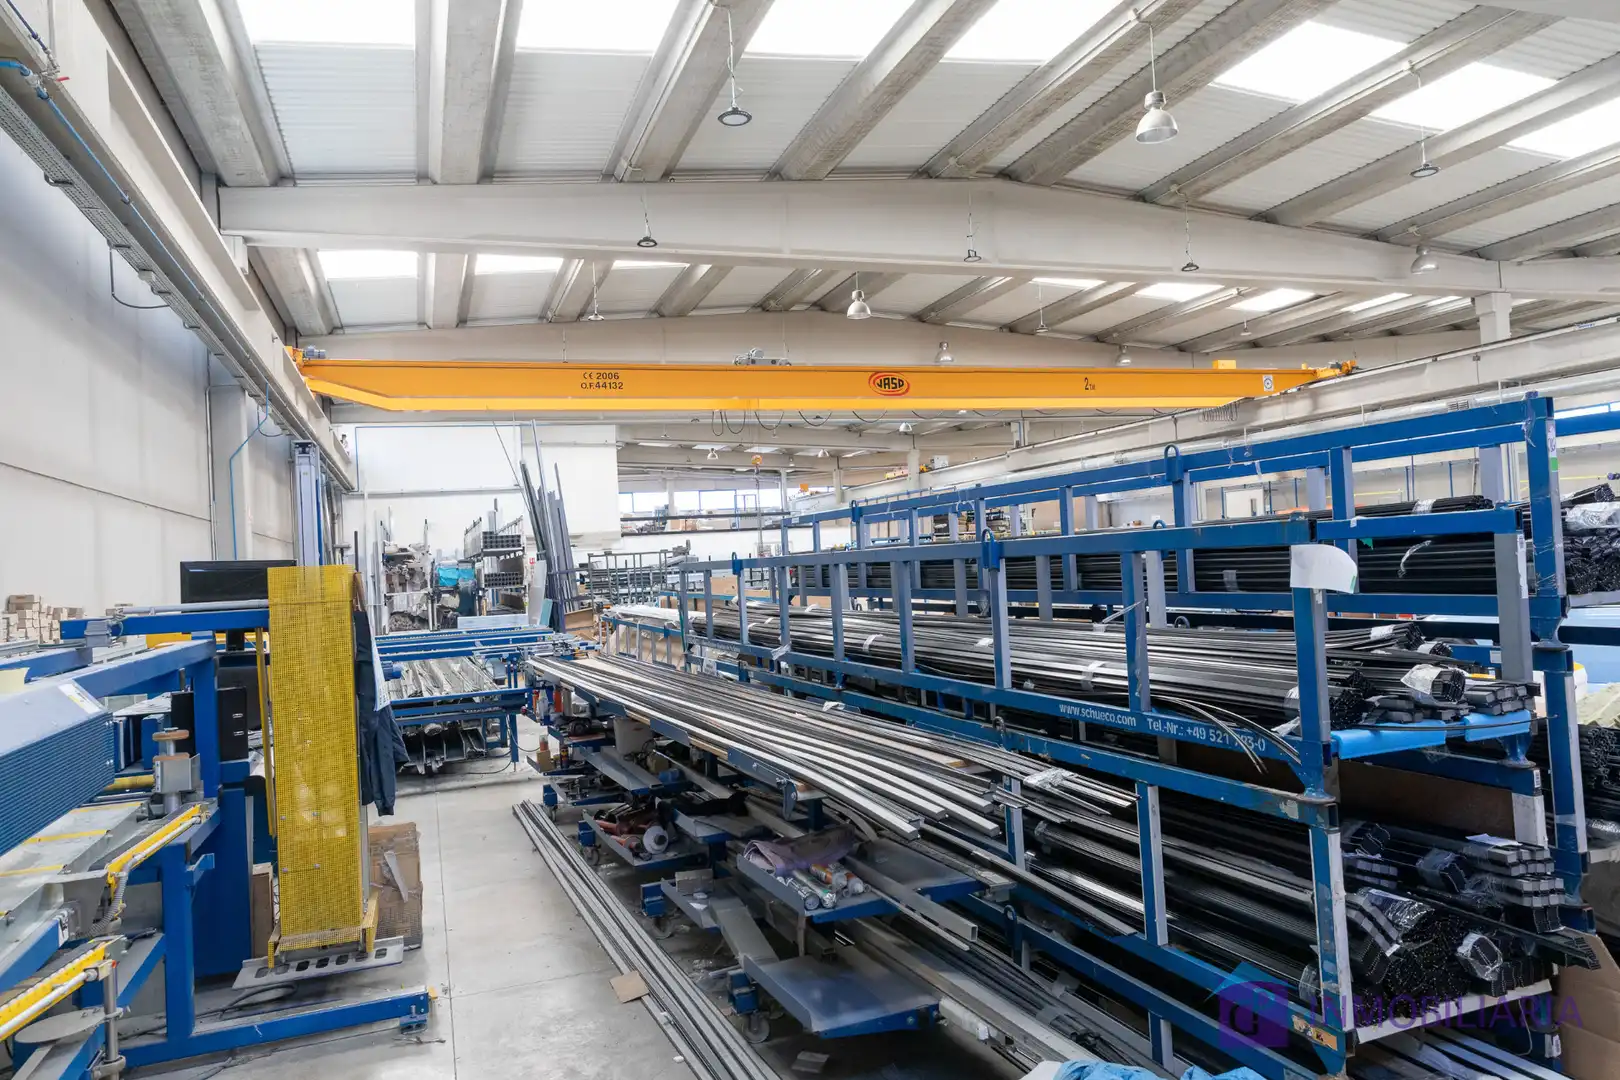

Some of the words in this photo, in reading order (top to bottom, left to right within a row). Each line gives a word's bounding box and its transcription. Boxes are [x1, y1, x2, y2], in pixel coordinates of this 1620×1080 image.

[596, 372, 620, 380] 2006
[1059, 703, 1137, 727] www.schueco.com
[1186, 725, 1206, 740] +49
[1209, 728, 1229, 745] 521
